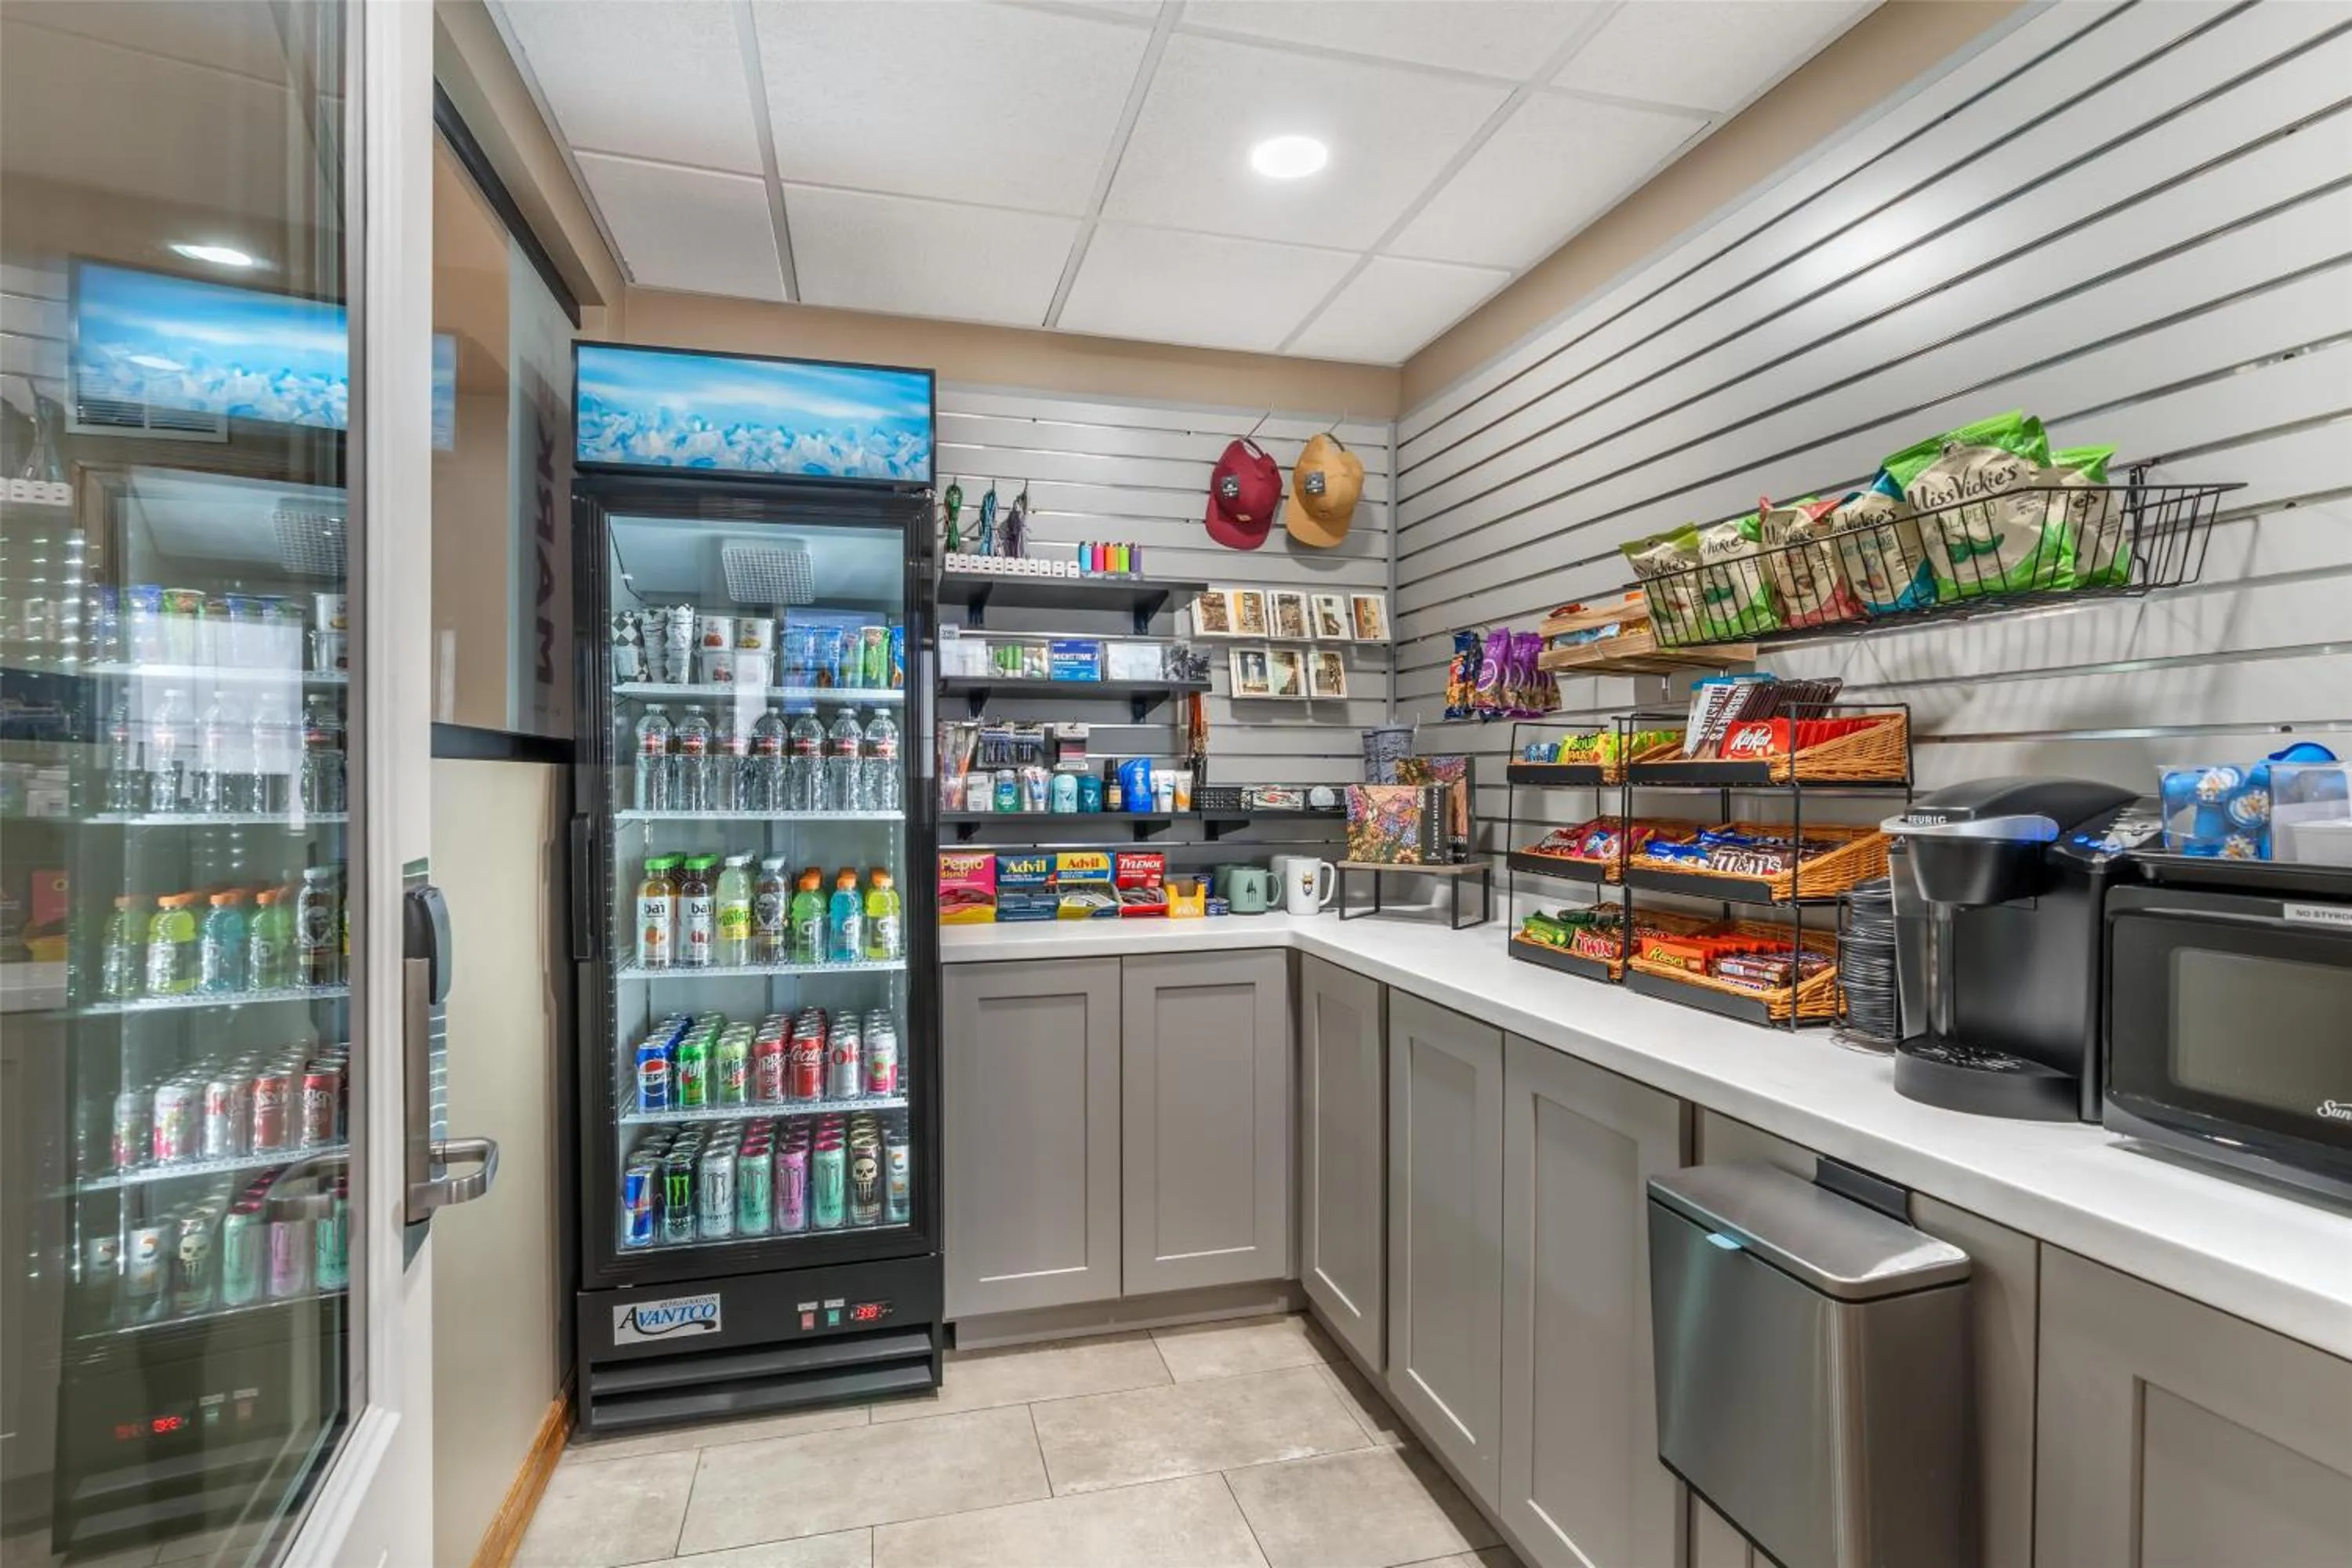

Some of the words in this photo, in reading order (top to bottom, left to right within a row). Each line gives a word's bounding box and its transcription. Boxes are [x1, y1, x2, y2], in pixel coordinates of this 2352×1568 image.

[1907, 485, 1955, 511] Miss
[1947, 463, 2018, 499] Vickie's
[941, 857, 984, 870] Pepto
[1006, 858, 1047, 873] Advil
[1067, 857, 1100, 868] Advil
[1120, 858, 1161, 869] TYLENOL
[644, 902, 666, 914] bai
[617, 1303, 717, 1334] AVANTCO
